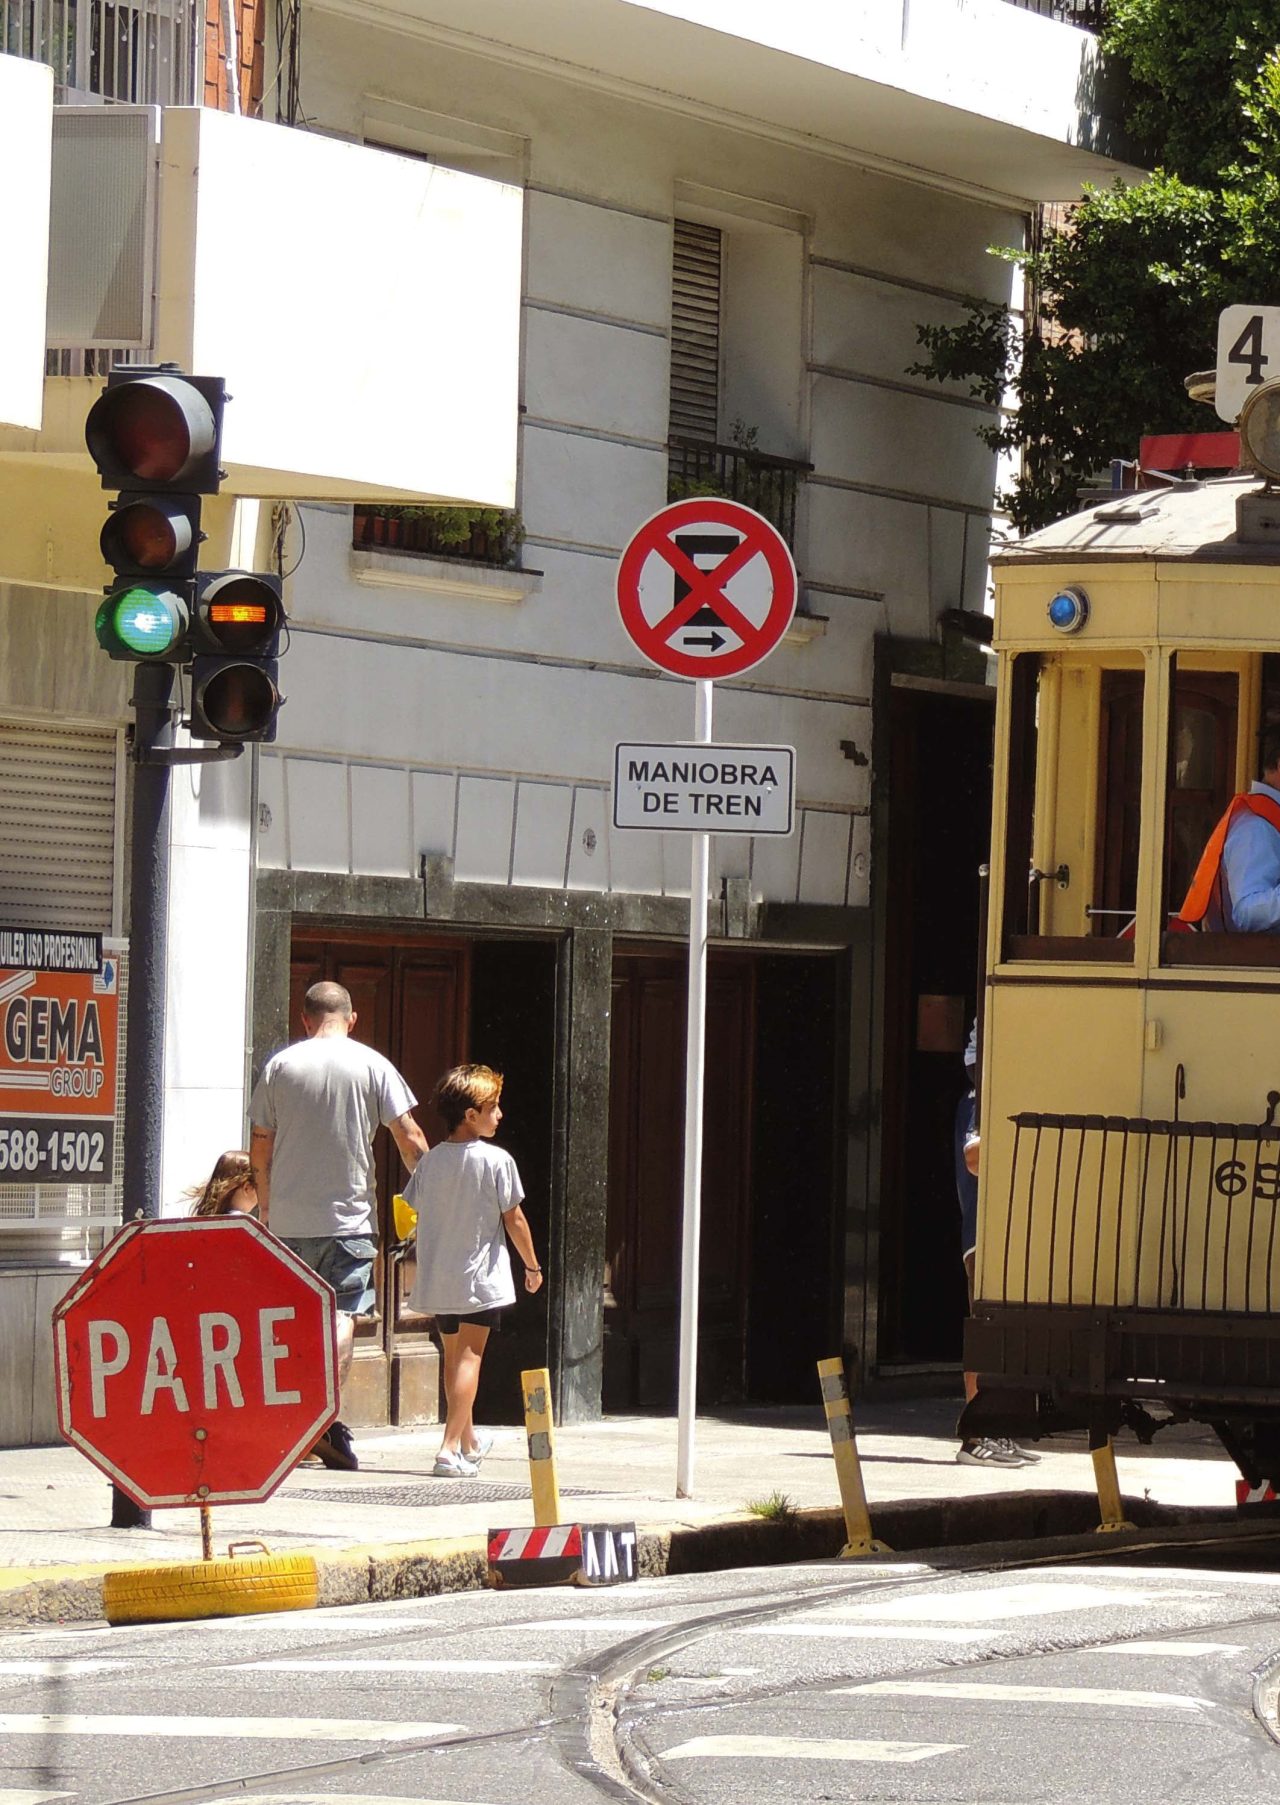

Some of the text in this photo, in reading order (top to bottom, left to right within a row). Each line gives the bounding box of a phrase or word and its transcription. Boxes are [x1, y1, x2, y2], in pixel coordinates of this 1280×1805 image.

[628, 761, 778, 786] MANIOBRA
[643, 792, 762, 816] DE TREN
[0, 931, 98, 970] UILER USO PROFESIONAL
[5, 995, 104, 1066] GEMA
[51, 1067, 104, 1099] GROUP
[87, 1306, 302, 1418] PARE
